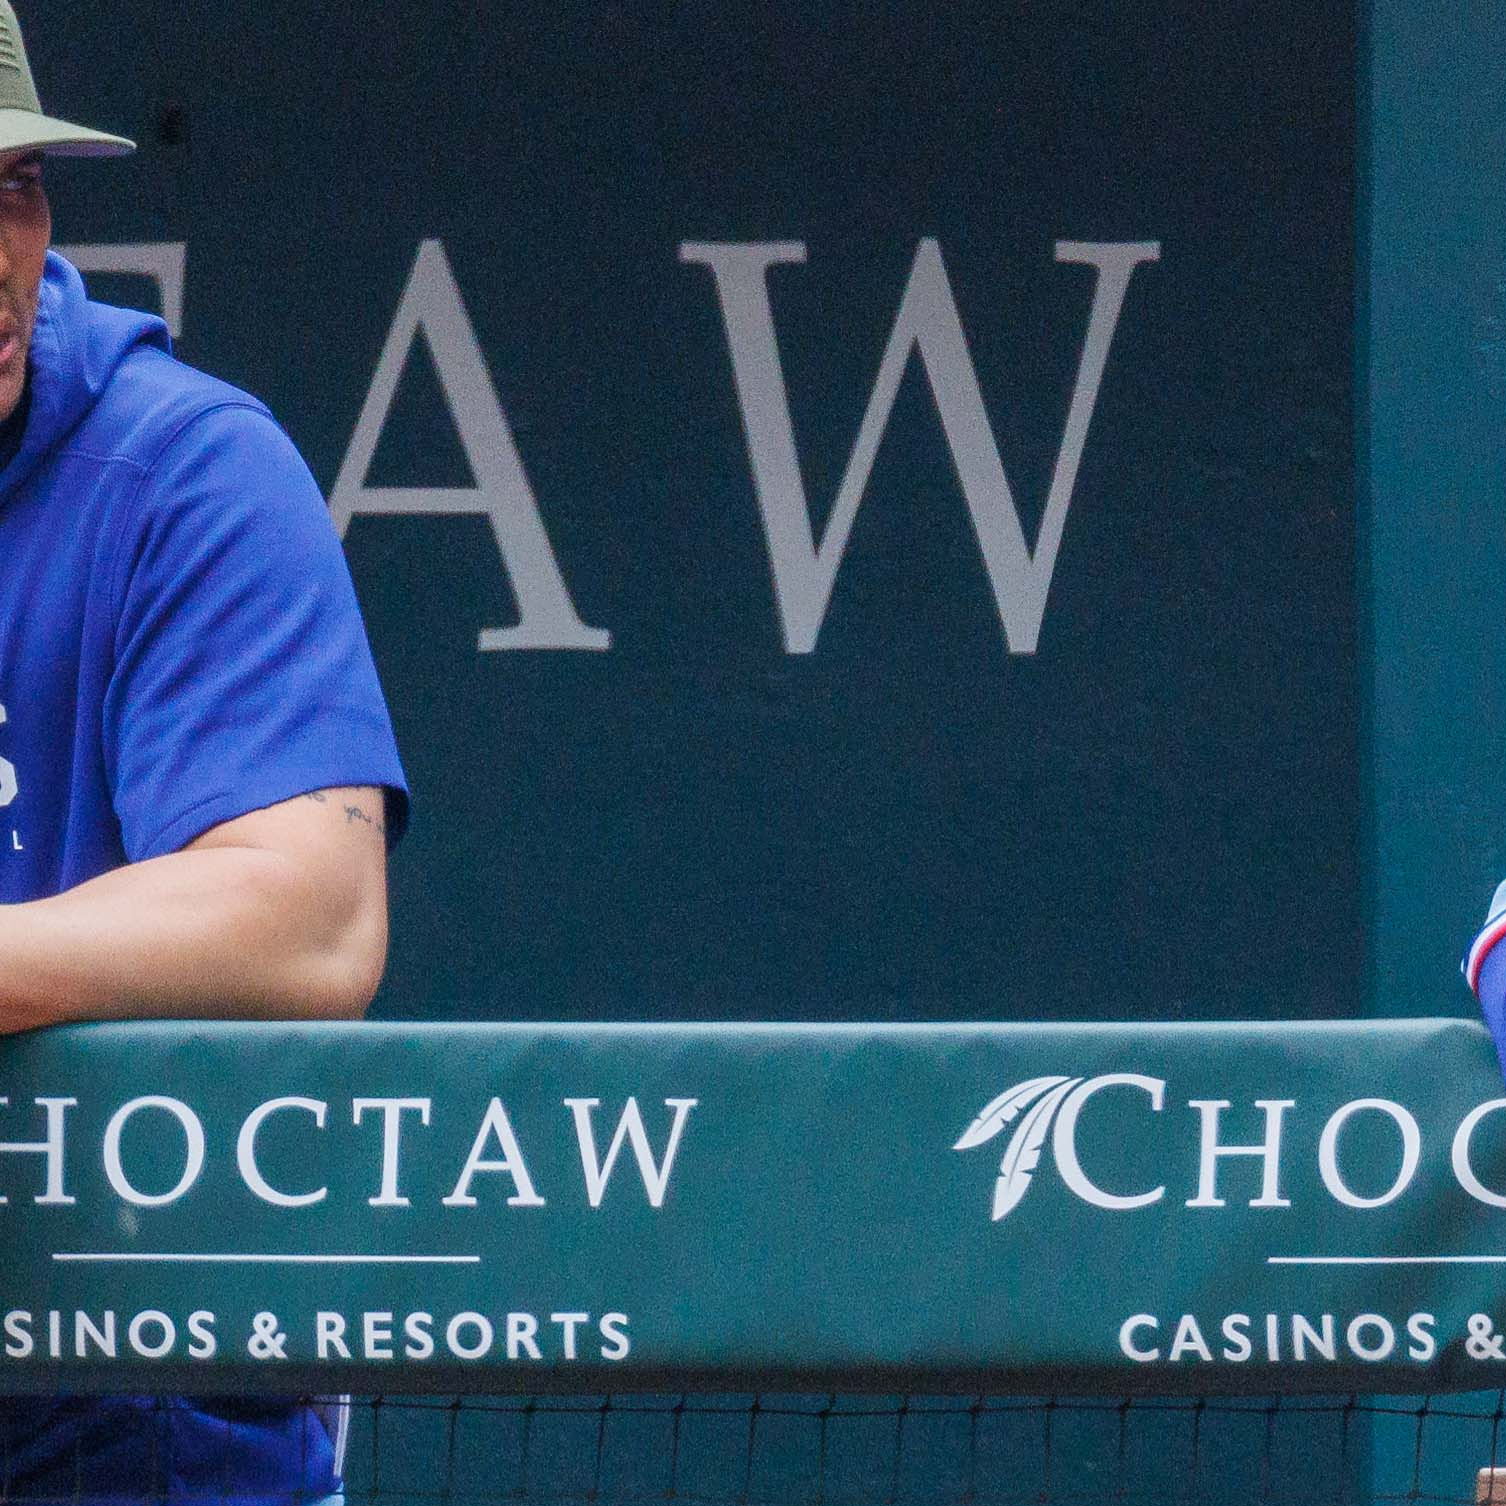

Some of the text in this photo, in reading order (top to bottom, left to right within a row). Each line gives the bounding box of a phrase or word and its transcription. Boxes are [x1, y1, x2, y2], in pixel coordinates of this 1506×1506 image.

[4, 1309, 631, 1361] SINOS & RESORTS
[1118, 1312, 1437, 1363] CASINOS
